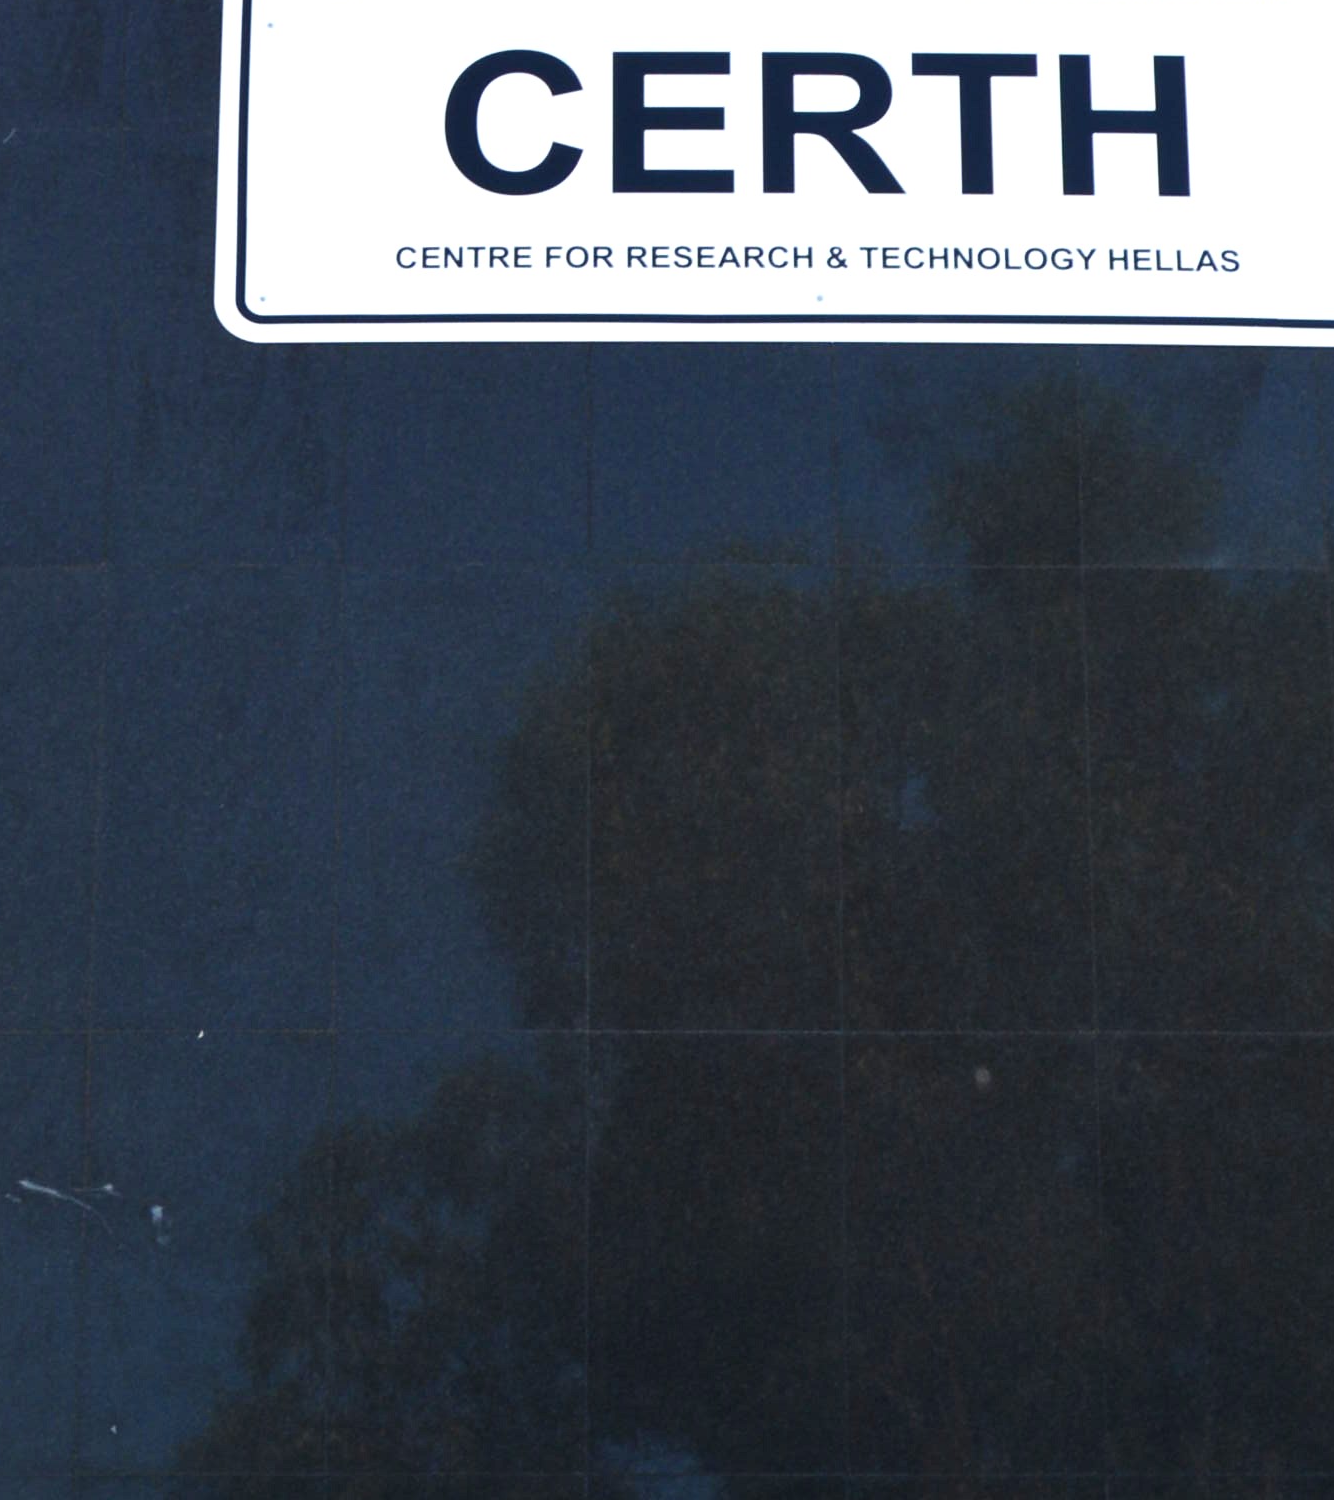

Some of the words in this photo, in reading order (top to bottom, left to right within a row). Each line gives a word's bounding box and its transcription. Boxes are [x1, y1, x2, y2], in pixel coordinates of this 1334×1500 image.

[445, 50, 1191, 197] CERTH
[396, 246, 532, 269] CENTRE
[545, 246, 613, 269] FOR
[627, 245, 813, 269] RESEARCH
[826, 246, 848, 269] &
[859, 246, 1096, 271] TECHNOLOGY
[1109, 248, 1240, 273] HELLAS
